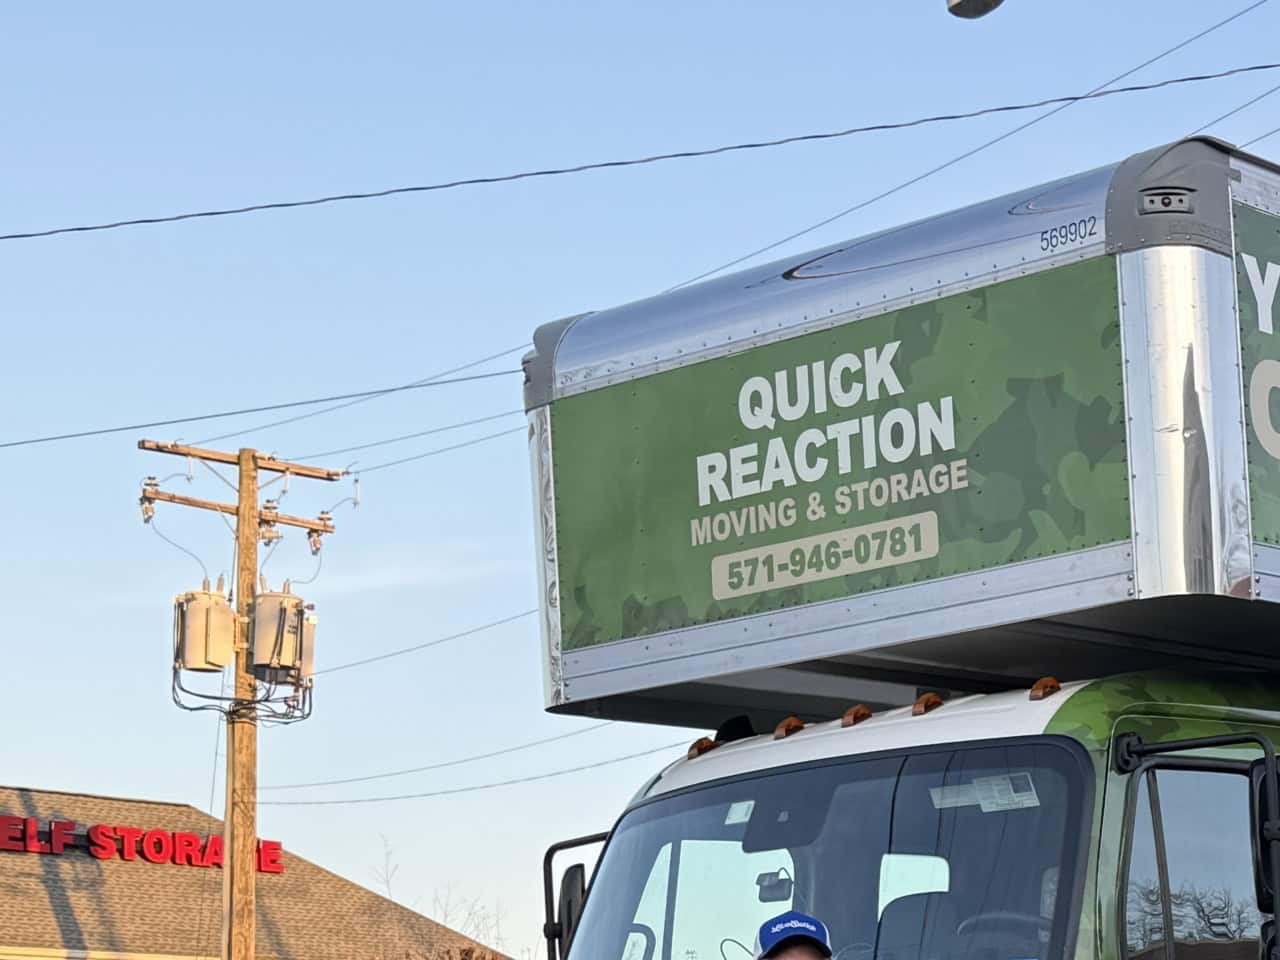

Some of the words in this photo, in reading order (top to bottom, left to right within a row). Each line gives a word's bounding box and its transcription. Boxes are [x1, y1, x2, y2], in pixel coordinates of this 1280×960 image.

[1040, 215, 1097, 251] 569902
[738, 340, 905, 430] QUICK
[696, 396, 956, 507] REACTION
[690, 497, 797, 547] MOVING
[806, 491, 826, 522] &
[834, 458, 969, 515] STORAGE
[727, 522, 923, 591] 571-946-0781
[88, 824, 285, 874] STORAE
